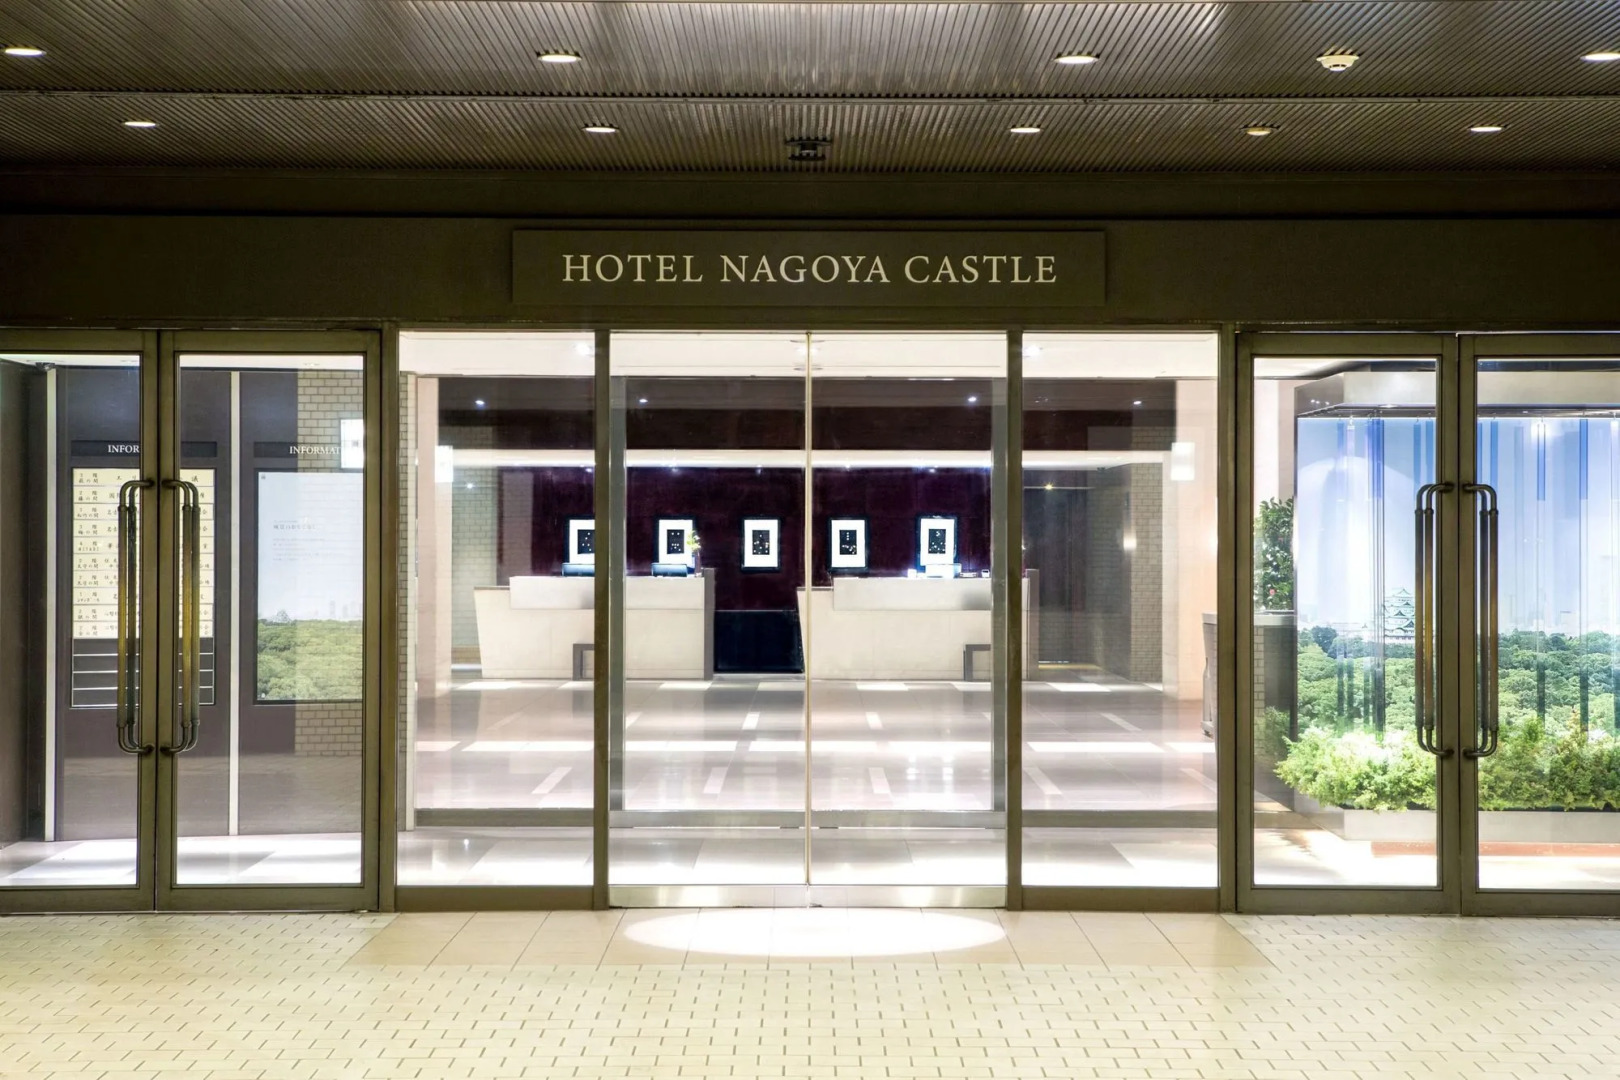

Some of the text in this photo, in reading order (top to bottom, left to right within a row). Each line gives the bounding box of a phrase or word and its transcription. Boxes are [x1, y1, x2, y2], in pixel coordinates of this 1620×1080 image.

[562, 253, 1058, 285] HOTEL NAGOYA CASTLE
[107, 444, 140, 454] INFOR
